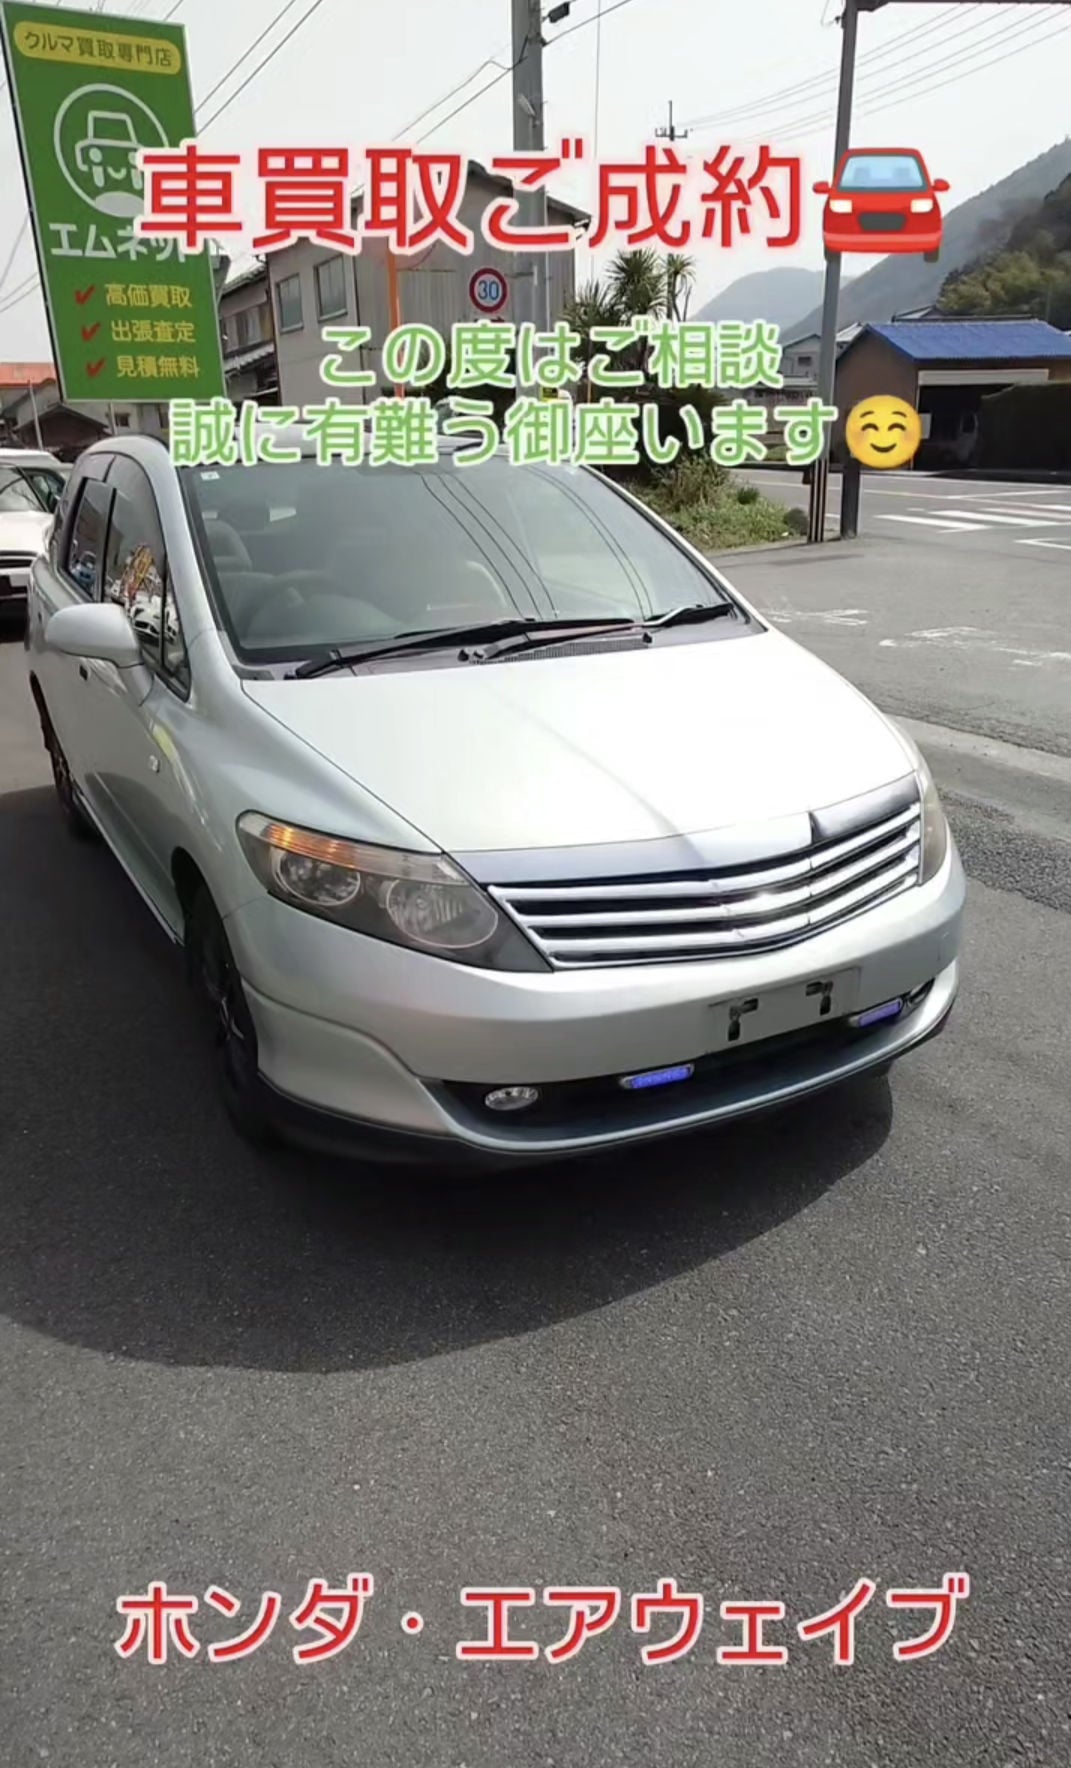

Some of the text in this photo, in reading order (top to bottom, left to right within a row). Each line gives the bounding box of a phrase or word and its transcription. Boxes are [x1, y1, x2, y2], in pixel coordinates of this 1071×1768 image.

[23, 29, 173, 68] クルマ買取専門店
[104, 284, 193, 308] 高価買取
[477, 280, 500, 301] 30
[110, 320, 196, 343] 出張査定
[116, 357, 200, 378] 見積無料
